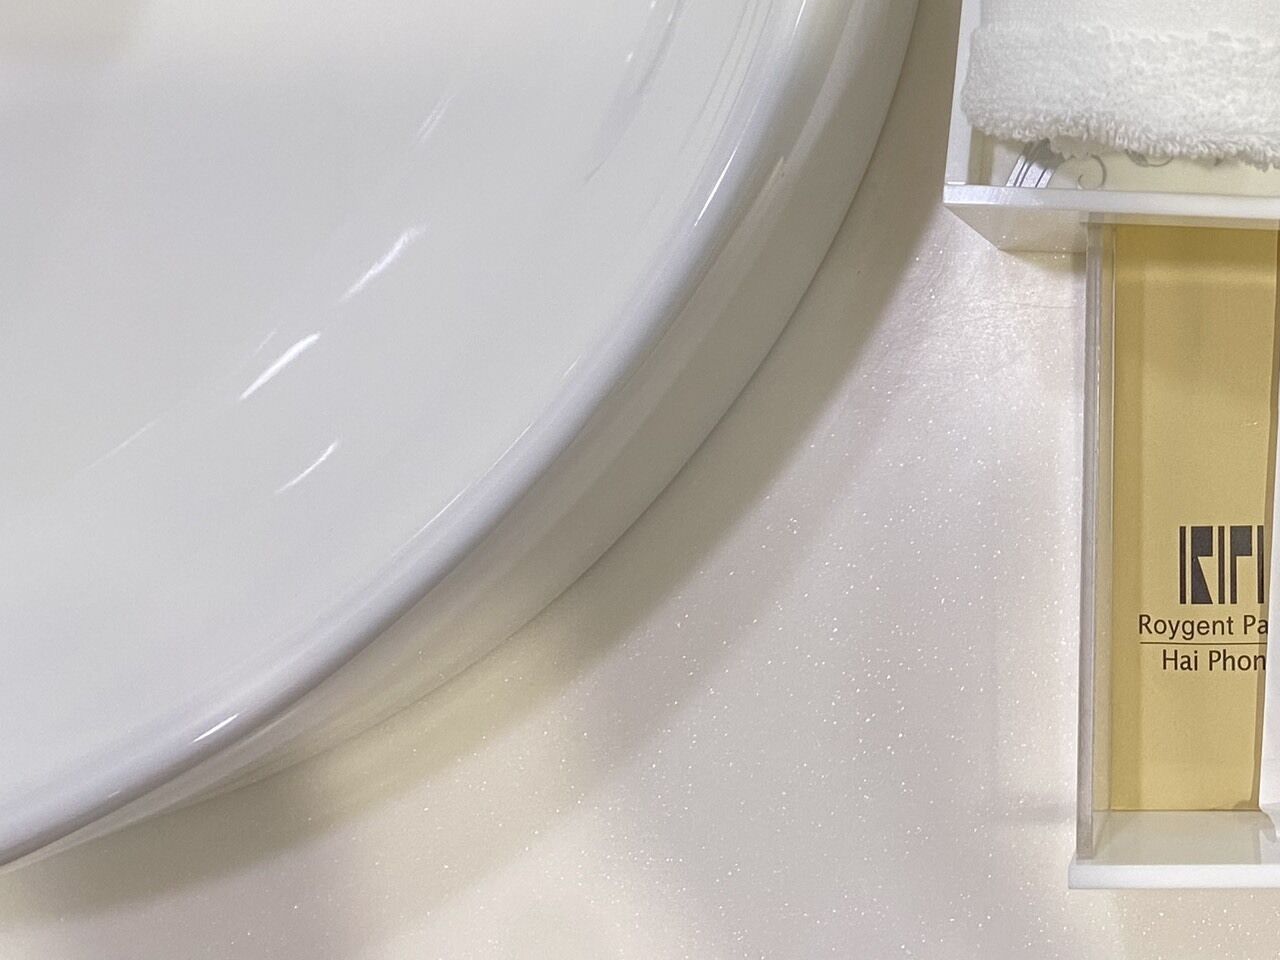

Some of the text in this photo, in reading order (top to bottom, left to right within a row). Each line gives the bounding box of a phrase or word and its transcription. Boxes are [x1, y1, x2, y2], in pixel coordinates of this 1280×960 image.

[1139, 614, 1269, 640] Roygent Pa
[1163, 649, 1266, 671] Hai Phon
